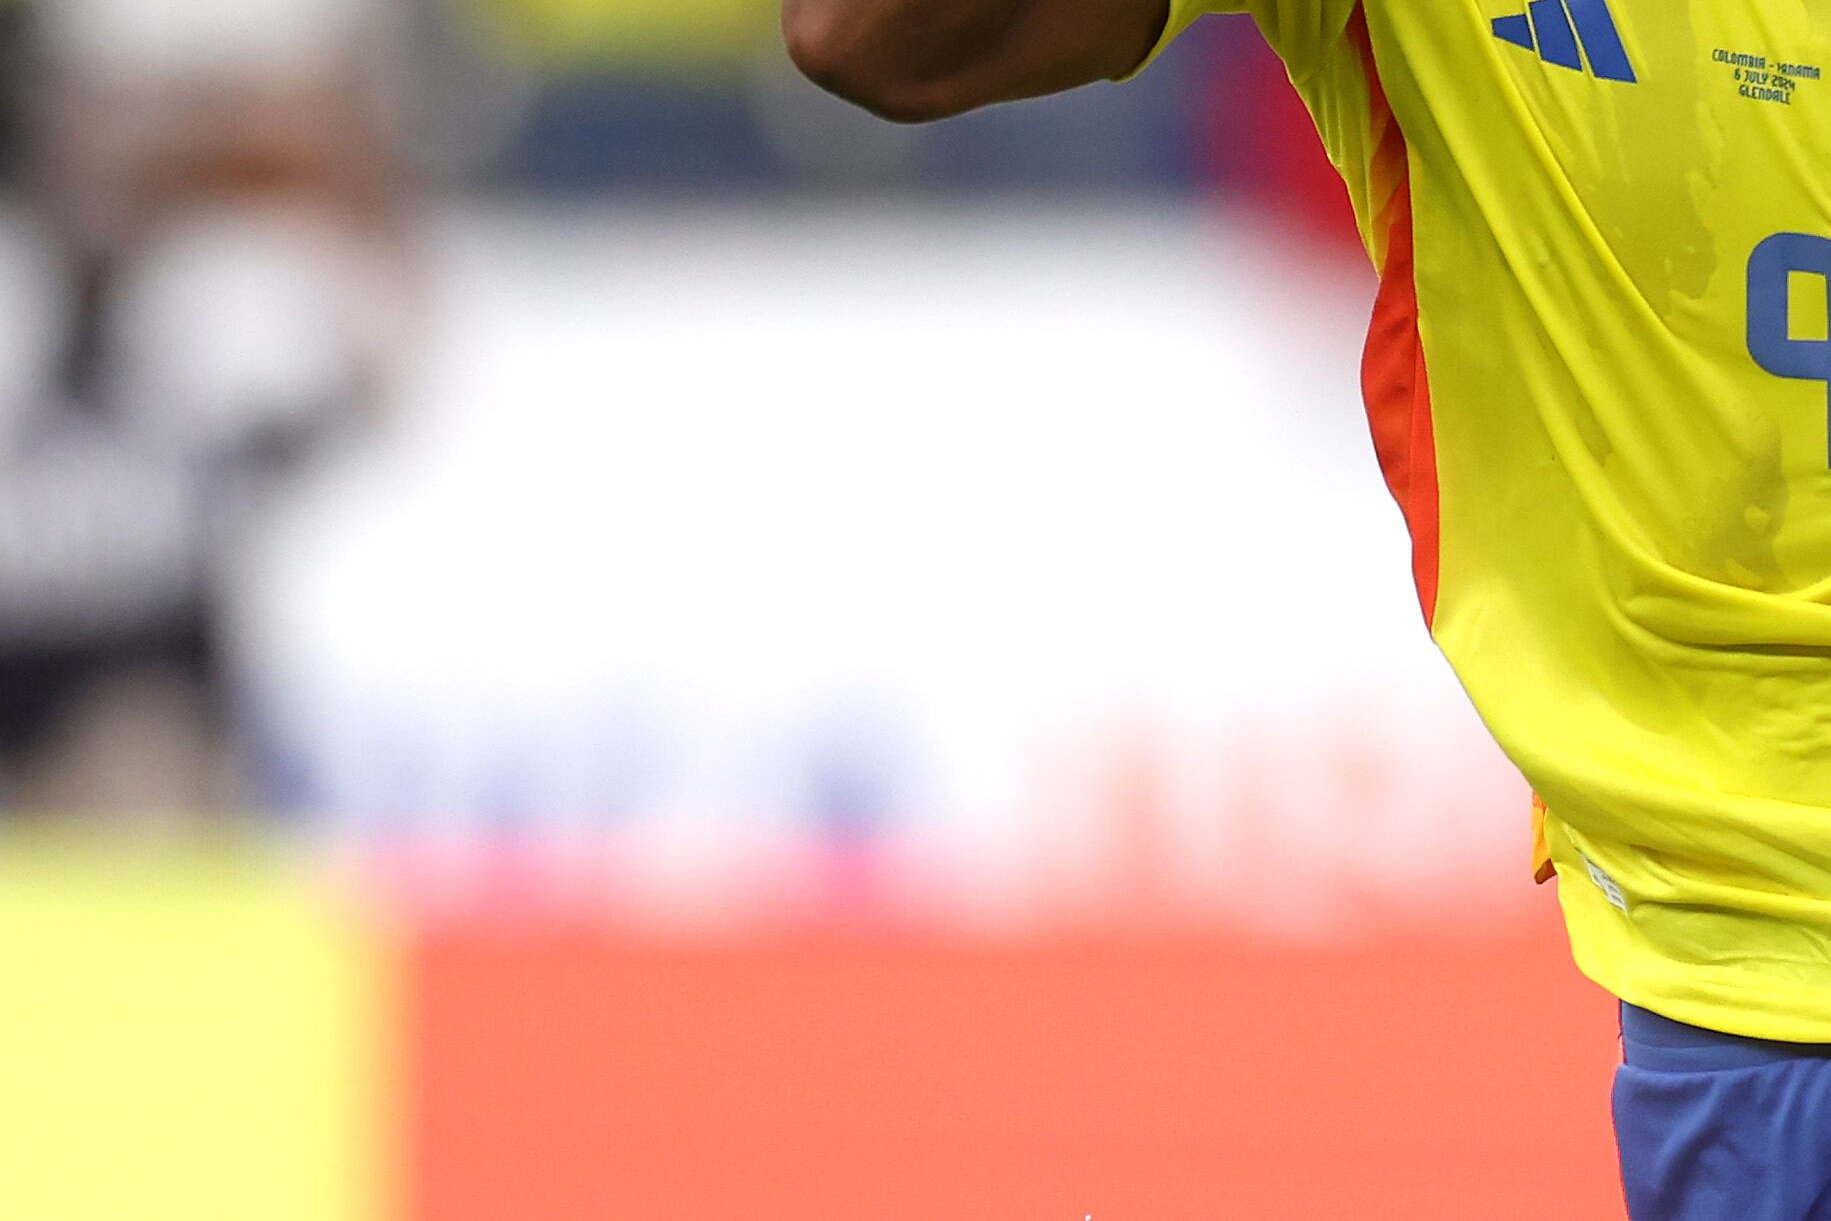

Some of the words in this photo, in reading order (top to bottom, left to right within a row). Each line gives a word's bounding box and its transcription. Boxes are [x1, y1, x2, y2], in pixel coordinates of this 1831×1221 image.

[1712, 49, 1766, 69] COLOMBIA
[1734, 68, 1741, 81] 6
[1744, 70, 1769, 85] JULY
[1738, 84, 1791, 105] GLENDALE
